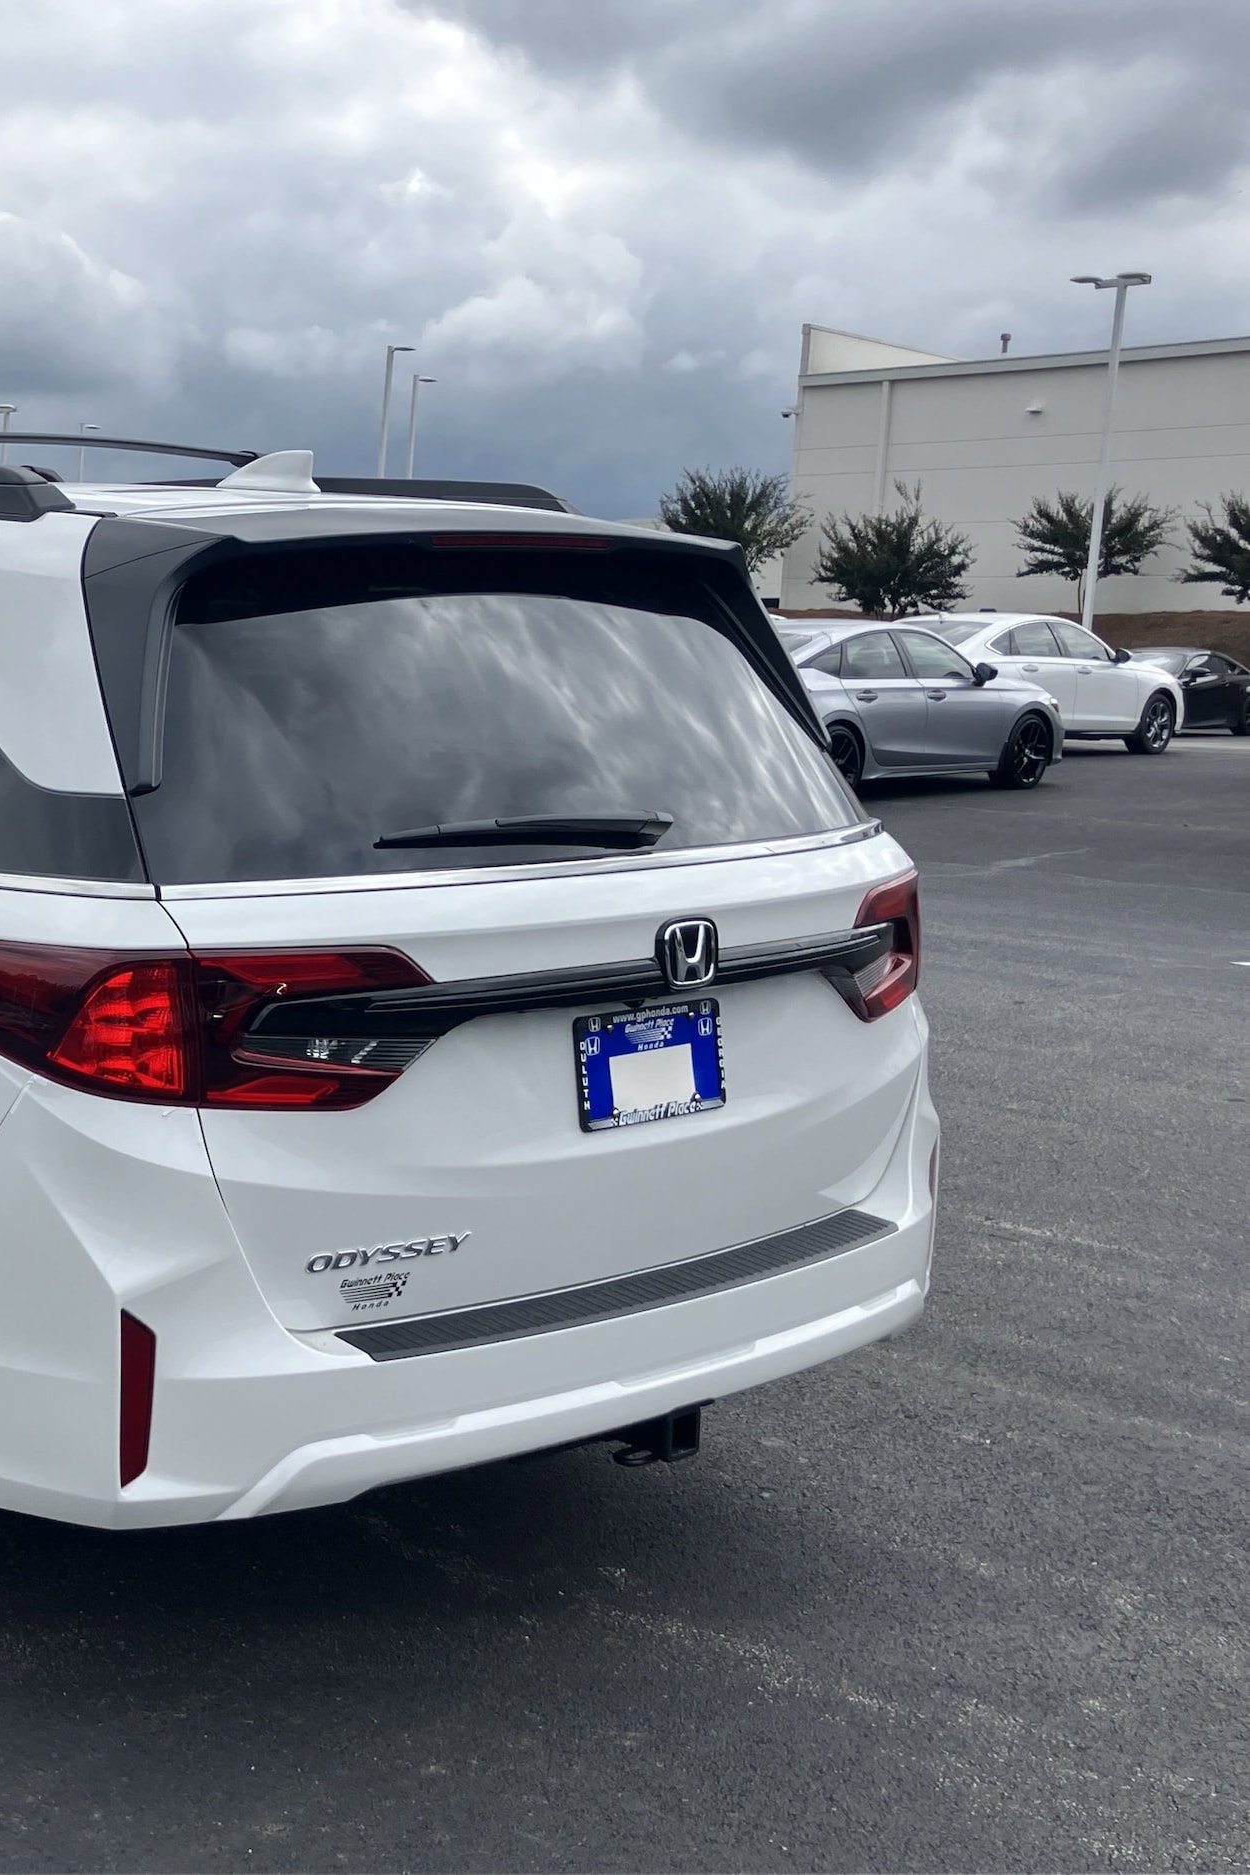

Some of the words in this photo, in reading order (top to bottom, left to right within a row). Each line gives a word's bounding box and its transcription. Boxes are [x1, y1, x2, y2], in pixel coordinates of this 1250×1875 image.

[612, 1004, 689, 1024] www.gphonda.com
[655, 1018, 675, 1028] Place
[637, 1041, 664, 1051] Honda
[579, 1041, 591, 1111] DULUTH
[667, 1101, 697, 1119] Place
[305, 1231, 472, 1274] ODYSSEY
[339, 1273, 383, 1289] Gwinnett
[384, 1271, 411, 1284] Place
[352, 1300, 390, 1312] Honda
